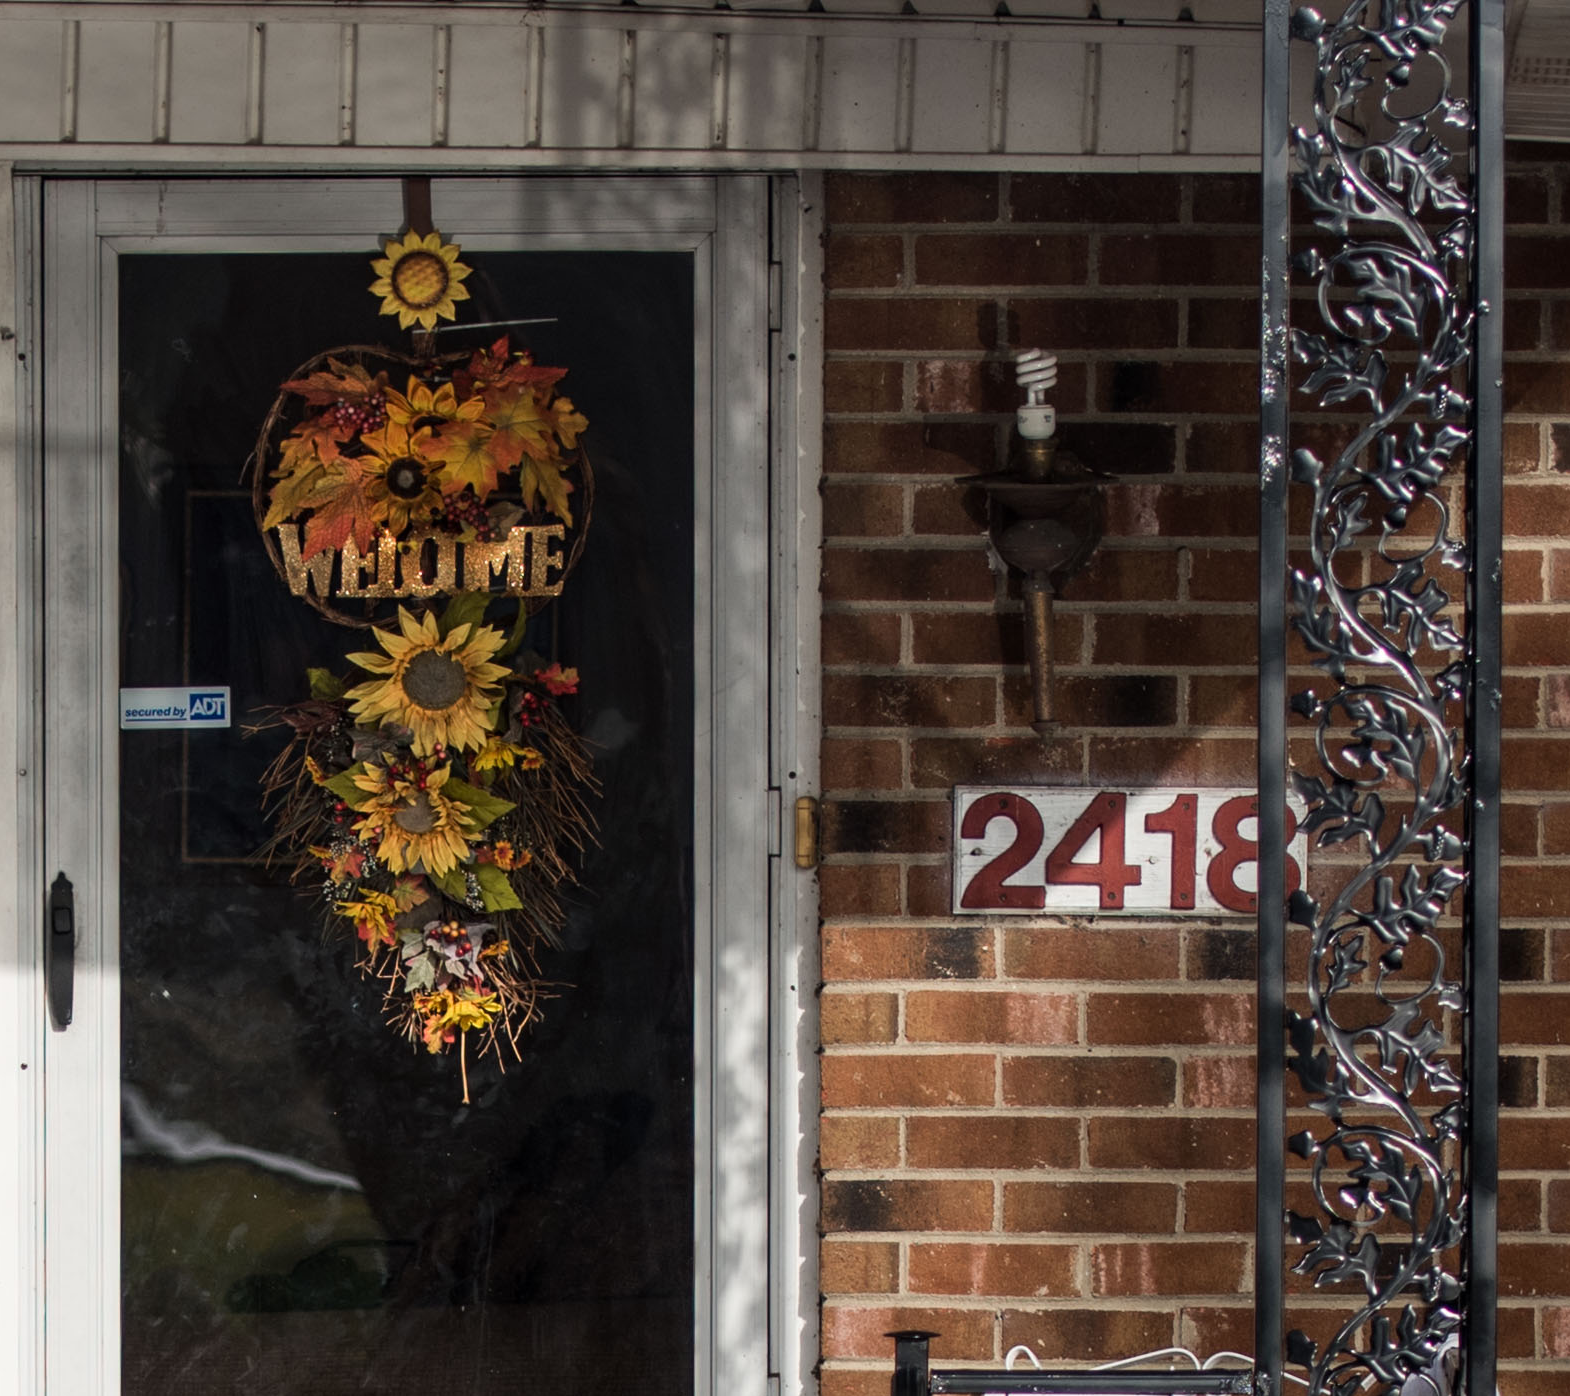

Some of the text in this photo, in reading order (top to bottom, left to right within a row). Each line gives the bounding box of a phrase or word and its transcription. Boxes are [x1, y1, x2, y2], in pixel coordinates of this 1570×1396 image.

[125, 706, 187, 718] secured by
[190, 697, 225, 716] ADT
[961, 791, 1302, 913] 2418
